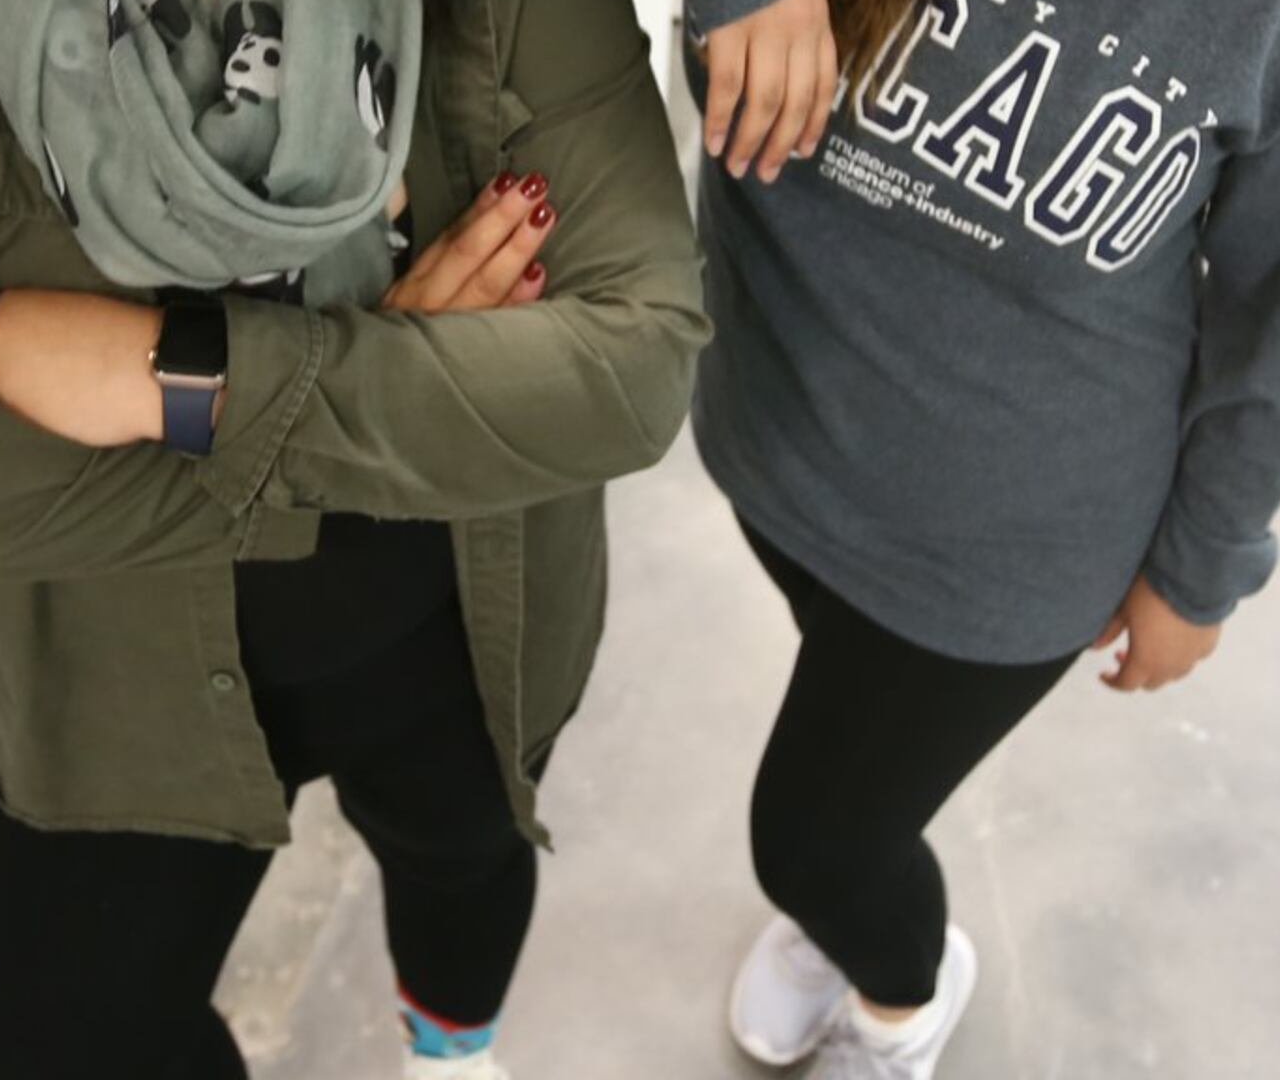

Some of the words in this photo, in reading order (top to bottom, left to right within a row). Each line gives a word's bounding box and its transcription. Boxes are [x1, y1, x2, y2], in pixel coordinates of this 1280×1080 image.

[819, 163, 893, 210] chicago
[828, 133, 911, 189] museum
[912, 180, 936, 199] of
